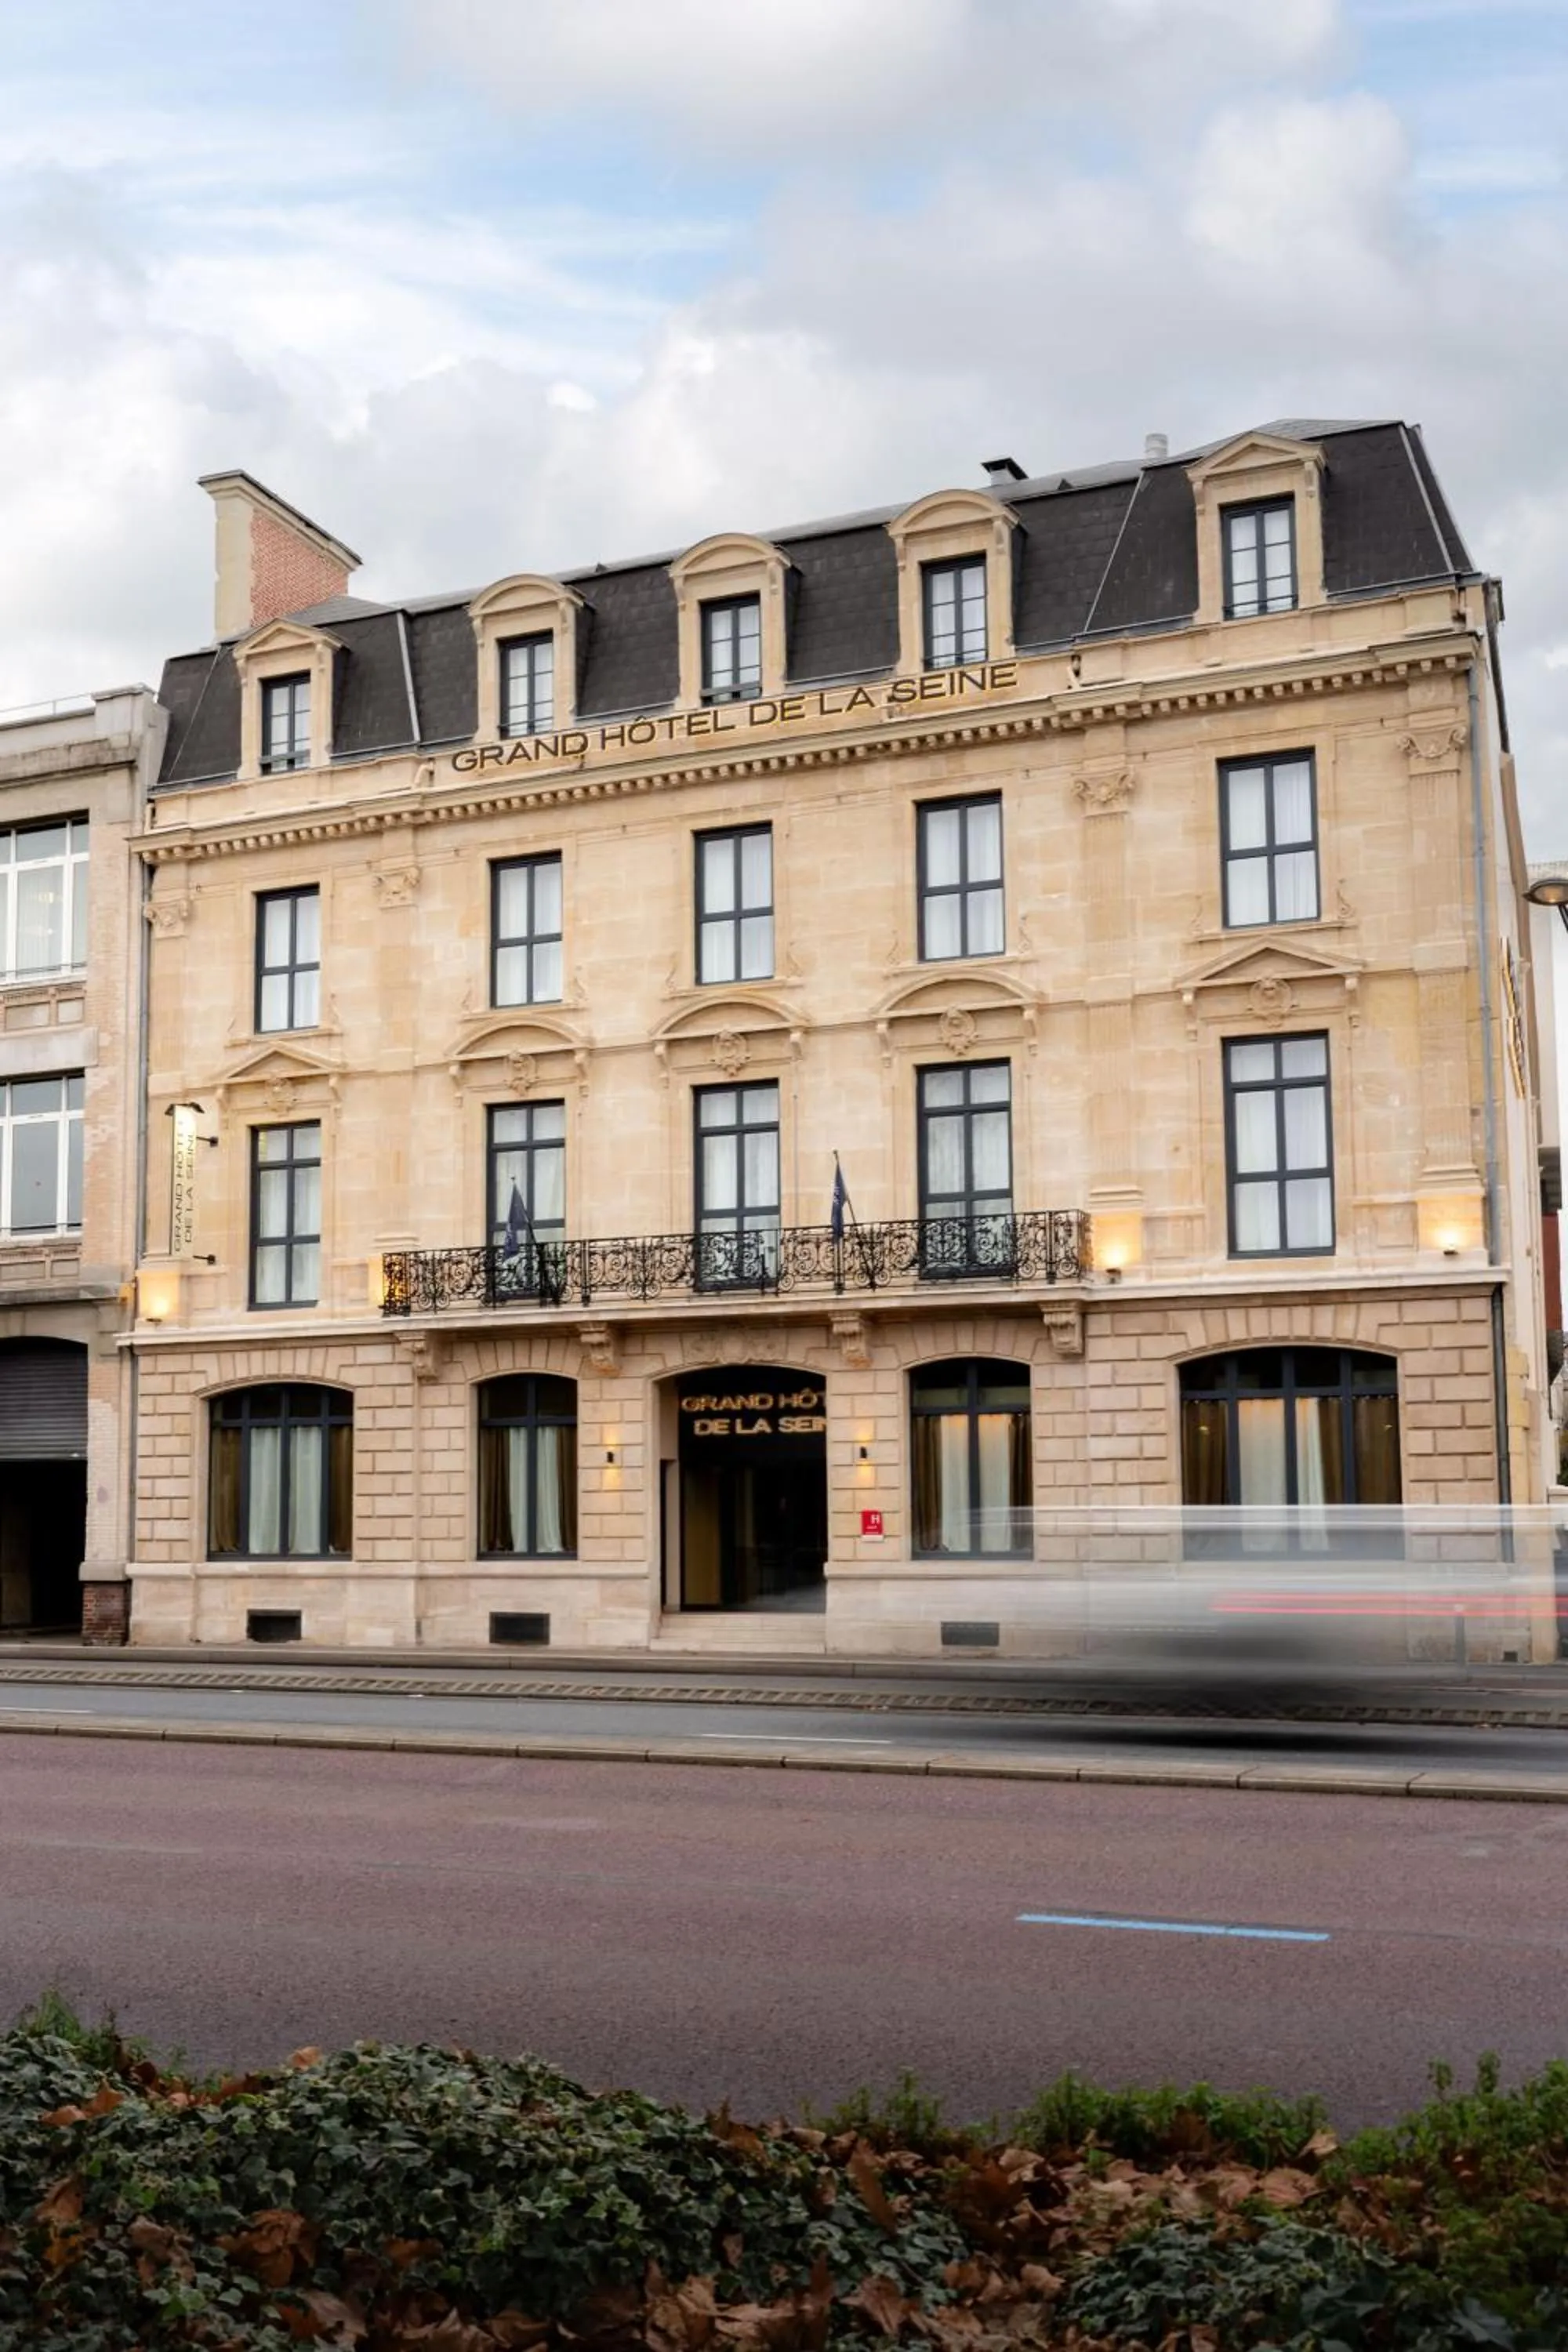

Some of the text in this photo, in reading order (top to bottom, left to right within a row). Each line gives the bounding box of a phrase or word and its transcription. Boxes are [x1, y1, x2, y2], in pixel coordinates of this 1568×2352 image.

[451, 662, 1018, 772] GRAND HÔTEL DE LA SEINE
[681, 1392, 773, 1411] GRAND
[693, 1417, 731, 1436] DE
[735, 1417, 772, 1435] LA
[871, 1514, 880, 1524] H
